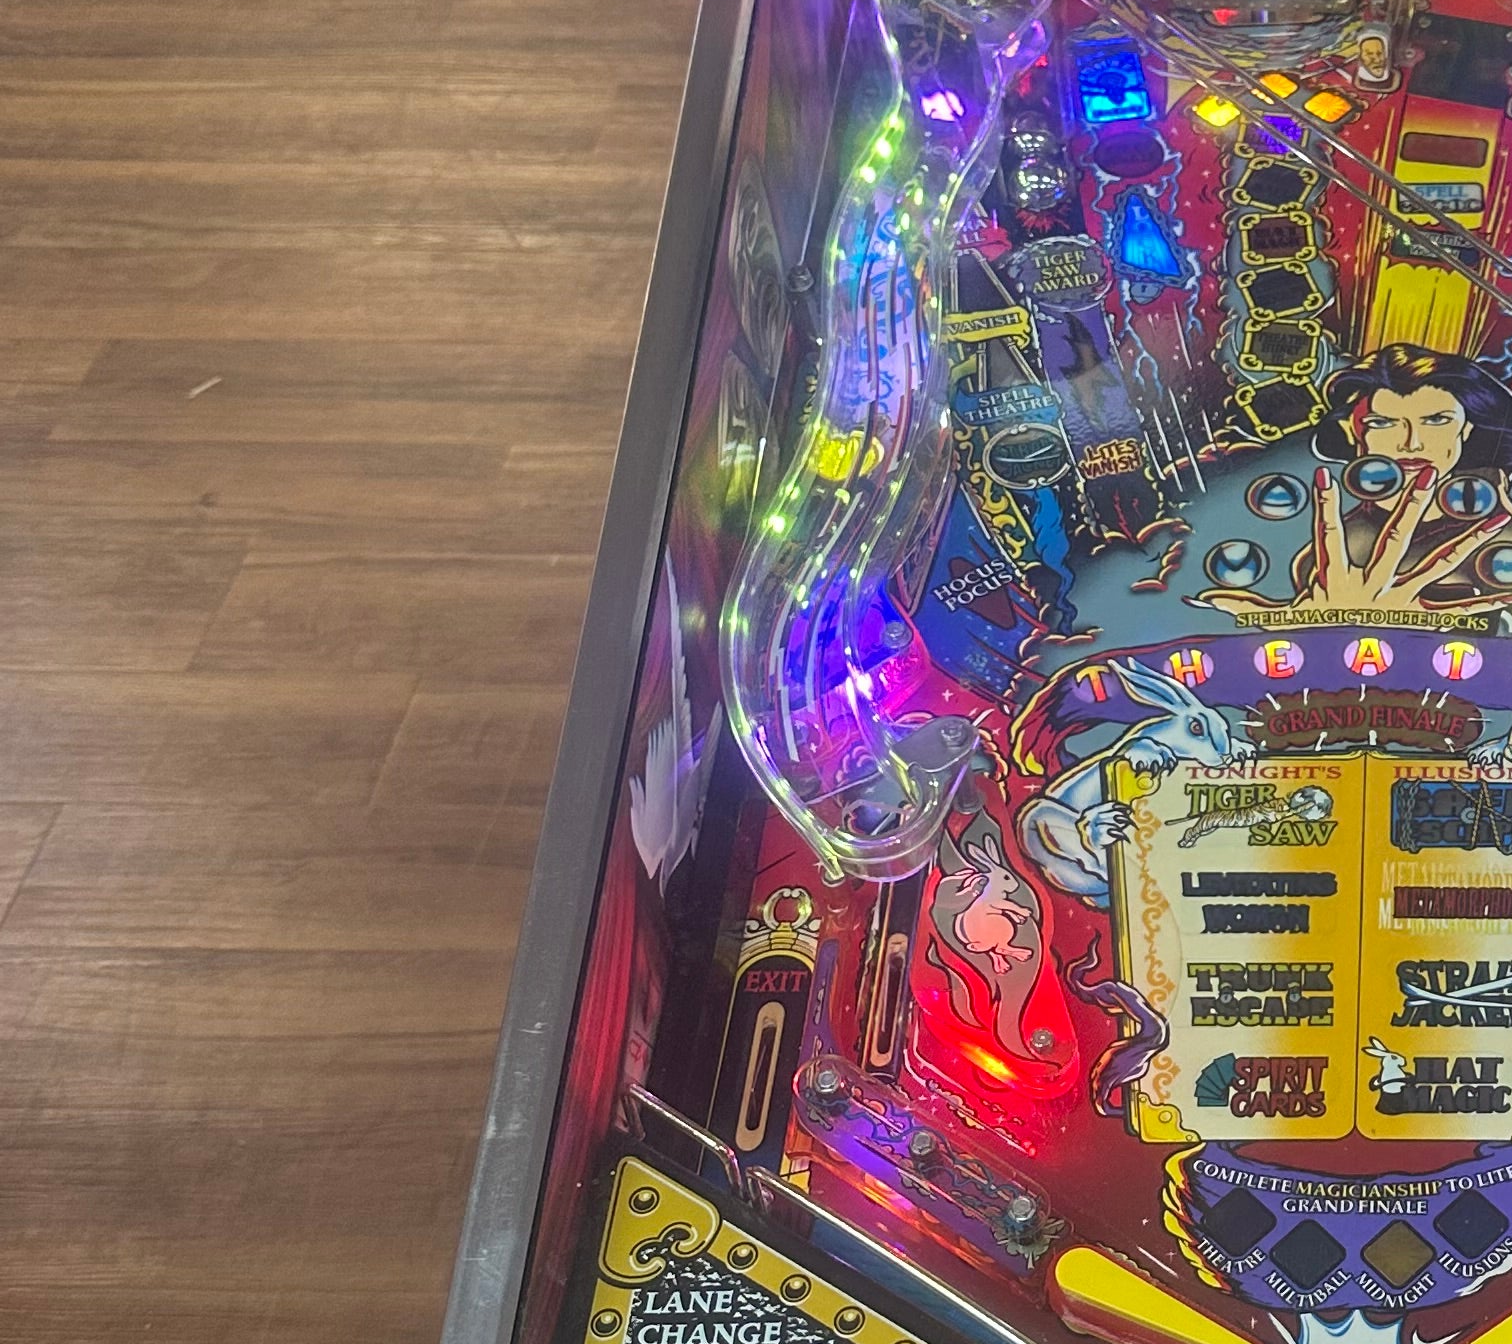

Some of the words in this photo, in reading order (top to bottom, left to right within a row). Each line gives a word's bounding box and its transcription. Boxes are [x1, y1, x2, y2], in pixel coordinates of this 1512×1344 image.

[1034, 250, 1087, 269] TIGER
[1042, 263, 1081, 280] SAW
[1033, 273, 1099, 293] AWARD
[947, 313, 1020, 334] VANISH
[965, 395, 1054, 422] THEATRE
[979, 388, 1034, 407] SPELL
[1085, 440, 1138, 461] LITES
[1080, 453, 1142, 479] VANISH
[934, 559, 1005, 600] HOCUS
[945, 571, 1013, 611] POCUS
[1236, 611, 1291, 628] SPELL
[1293, 609, 1360, 625] MAGIC
[1361, 609, 1388, 625] TO
[1389, 611, 1428, 626] LITE
[1431, 614, 1489, 630] LOCKS
[1268, 708, 1365, 736] GRAND
[1369, 708, 1468, 737] FINALE
[1185, 766, 1342, 780] TONIGHT'S
[1185, 783, 1276, 817] TIGER
[1249, 821, 1338, 846] SAW
[744, 971, 806, 994] EXIT
[1187, 963, 1334, 992] TRUNK
[1190, 996, 1334, 1026] ESCAPE
[1232, 1056, 1329, 1092] SPIRIT
[1413, 1057, 1504, 1083] HAT
[1231, 1091, 1327, 1117] CARDS
[1403, 1085, 1512, 1114] MAGIC
[1193, 1159, 1291, 1193] COMPLETE
[1296, 1180, 1442, 1199] MAGICIANSHIP
[1446, 1175, 1473, 1192] TO
[1283, 1199, 1353, 1214] GRAND
[1358, 1199, 1428, 1215] FINALE
[1197, 1236, 1267, 1274] THEATRE
[1265, 1270, 1352, 1307] MULTIBALL
[1355, 1272, 1437, 1308] MIDNIGHT
[644, 1289, 733, 1315] LANE
